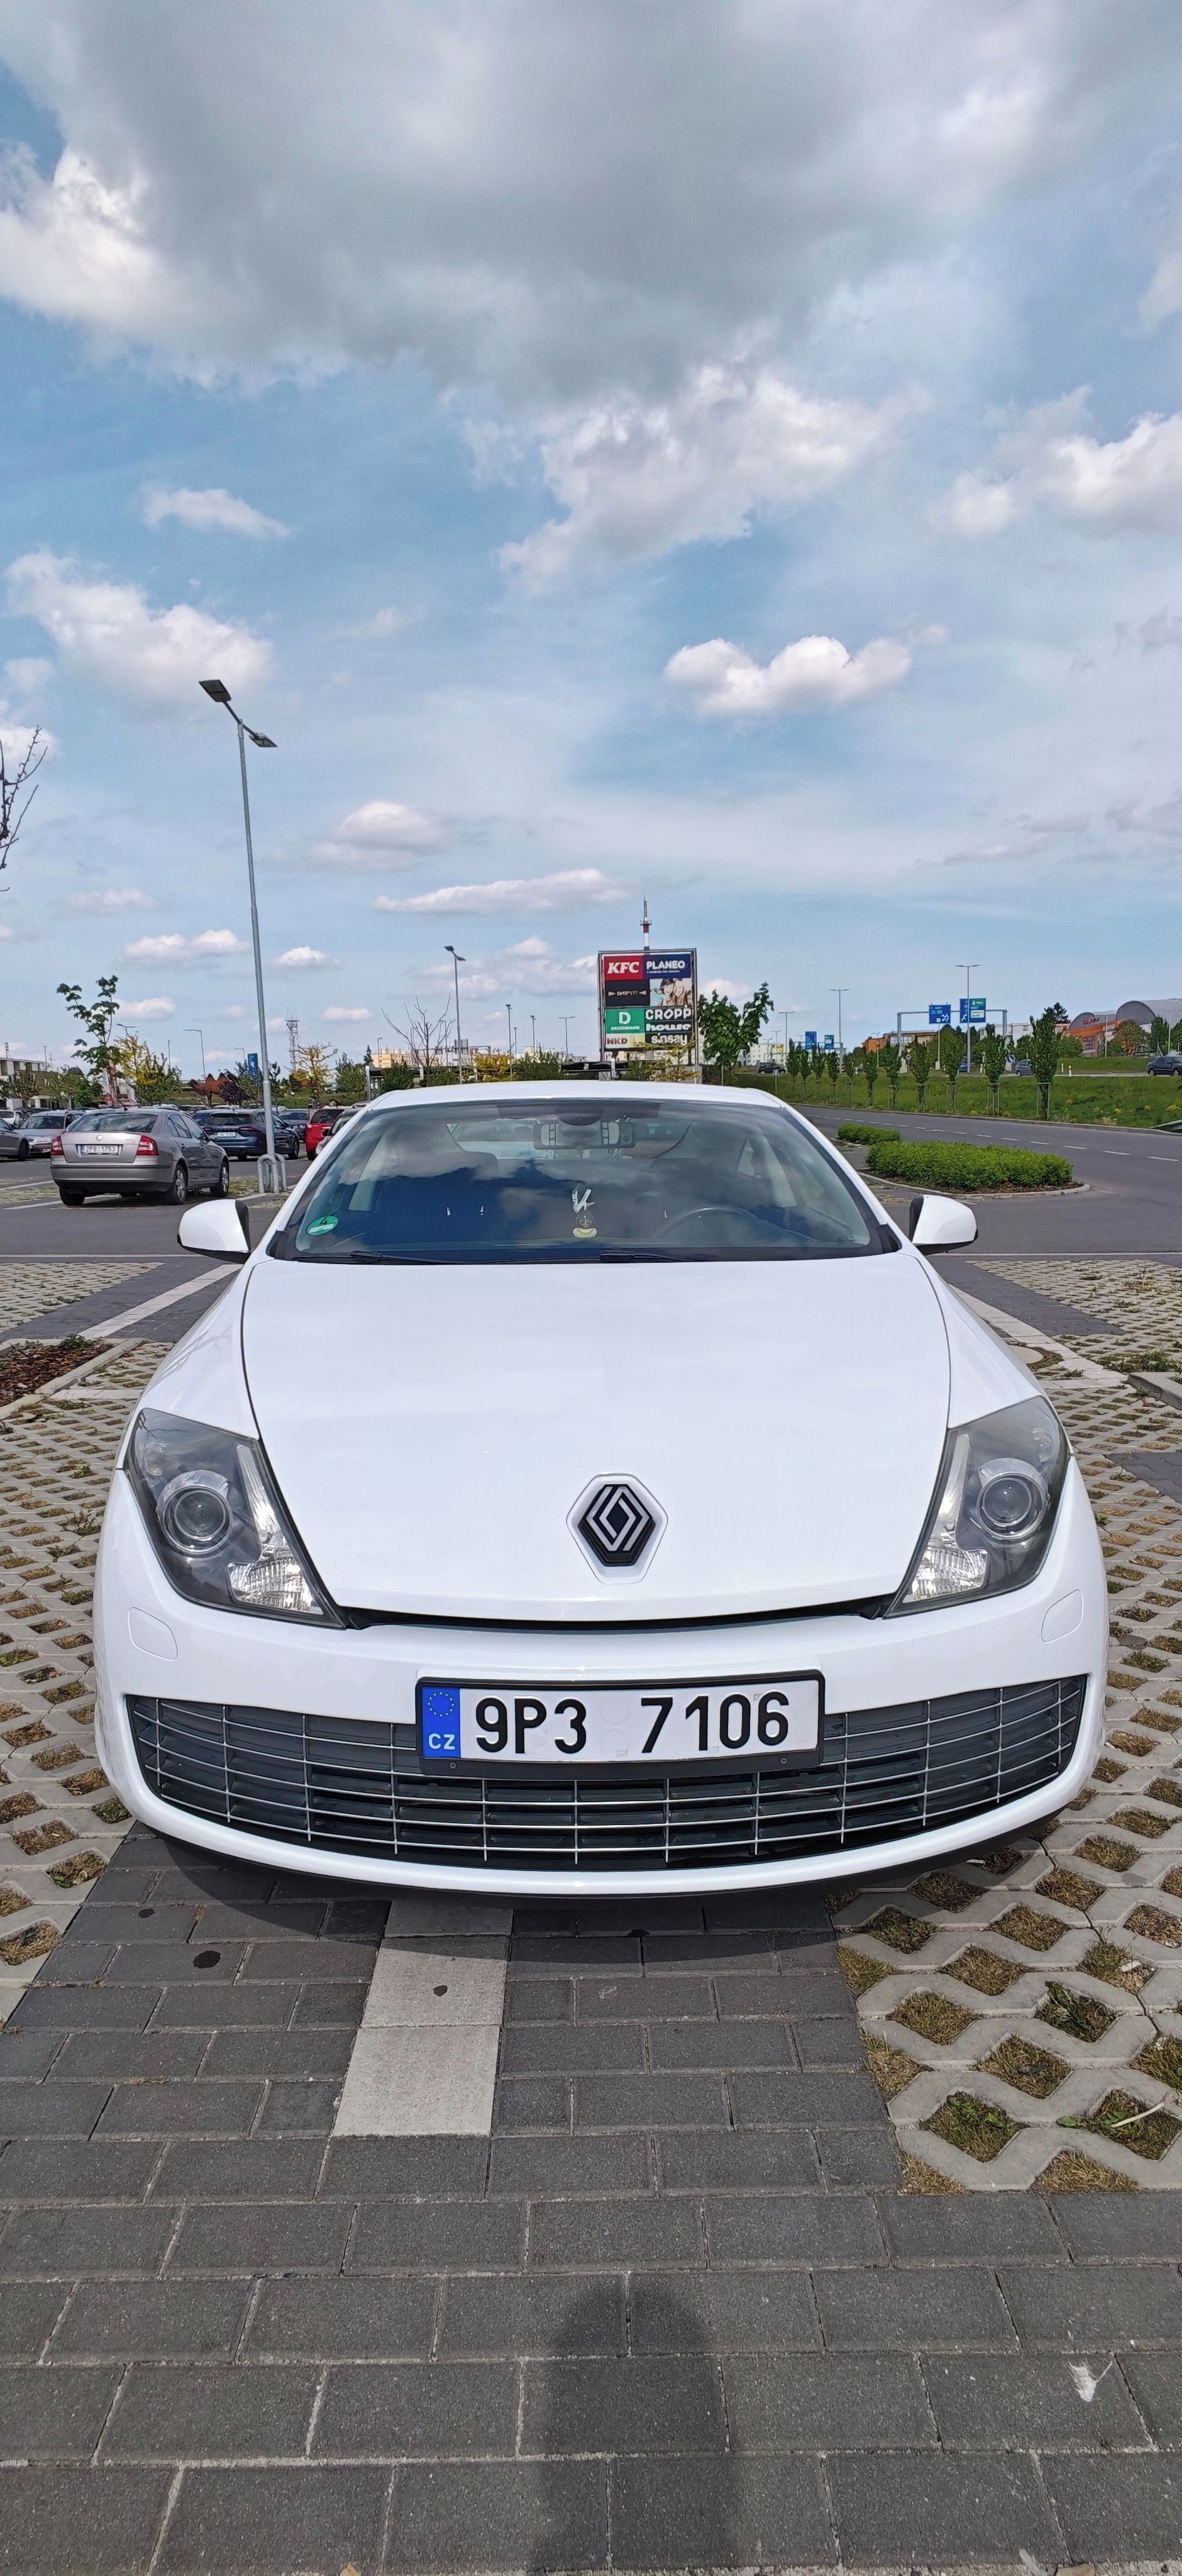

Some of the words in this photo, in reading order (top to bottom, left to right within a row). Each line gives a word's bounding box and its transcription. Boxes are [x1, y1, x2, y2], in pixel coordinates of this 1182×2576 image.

[607, 962, 639, 974] KFC
[646, 960, 685, 970] PLANEO
[619, 1011, 631, 1024] D
[646, 1008, 692, 1020] CROPP
[646, 1023, 692, 1031] house
[651, 1033, 688, 1045] sinsay
[319, 1217, 328, 1225] 4
[475, 1696, 587, 1754] 9P3
[641, 1690, 790, 1753] 7106
[428, 1733, 455, 1750] CZ
